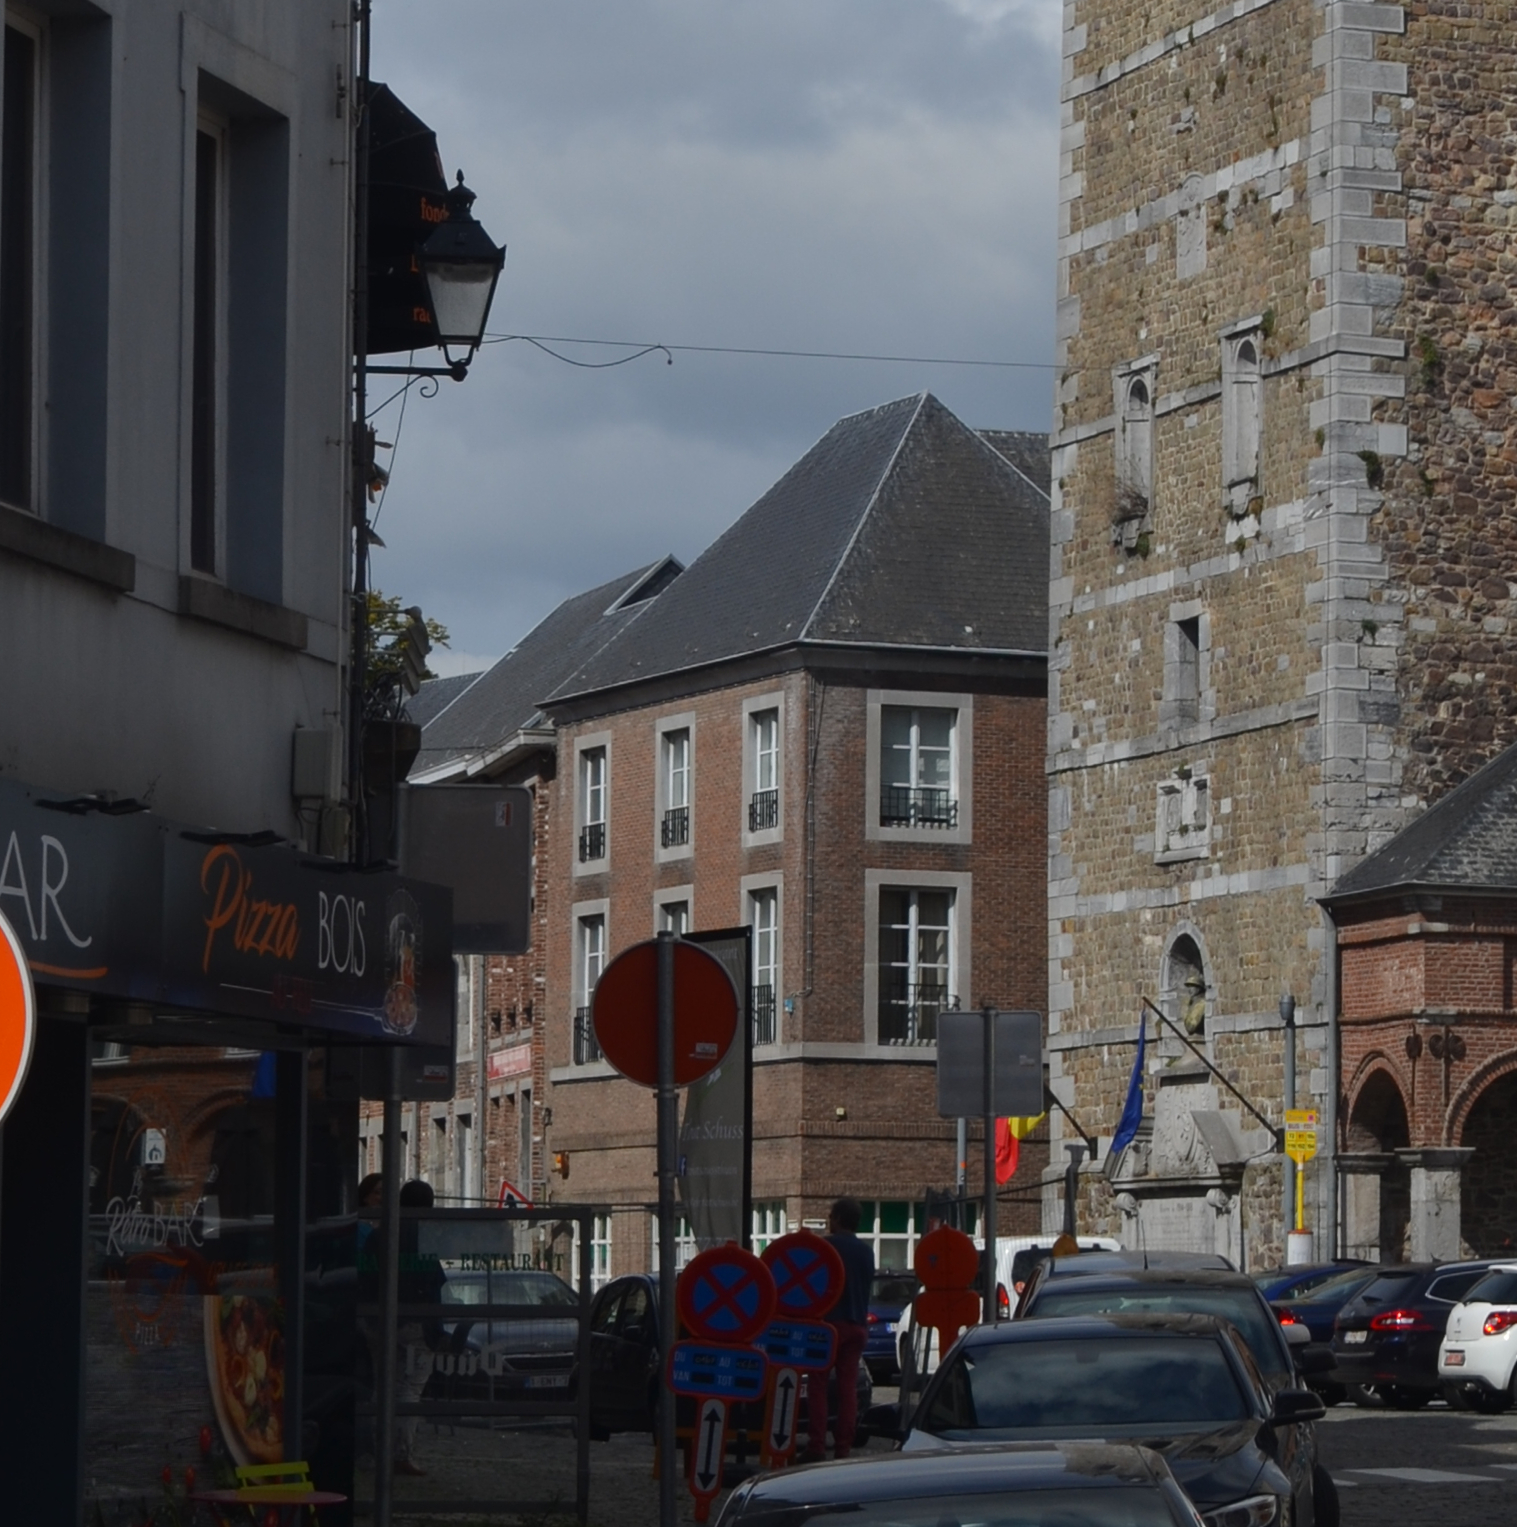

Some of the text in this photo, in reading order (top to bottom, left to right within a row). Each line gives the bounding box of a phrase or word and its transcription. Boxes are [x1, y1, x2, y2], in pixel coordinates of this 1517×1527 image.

[200, 844, 366, 978] Pizza BOIS
[153, 1200, 204, 1248] BAR
[460, 1253, 564, 1272] RESTAURANT
[674, 1351, 687, 1362] DU
[718, 1357, 731, 1368] AU
[672, 1370, 733, 1386] VAN TOT
